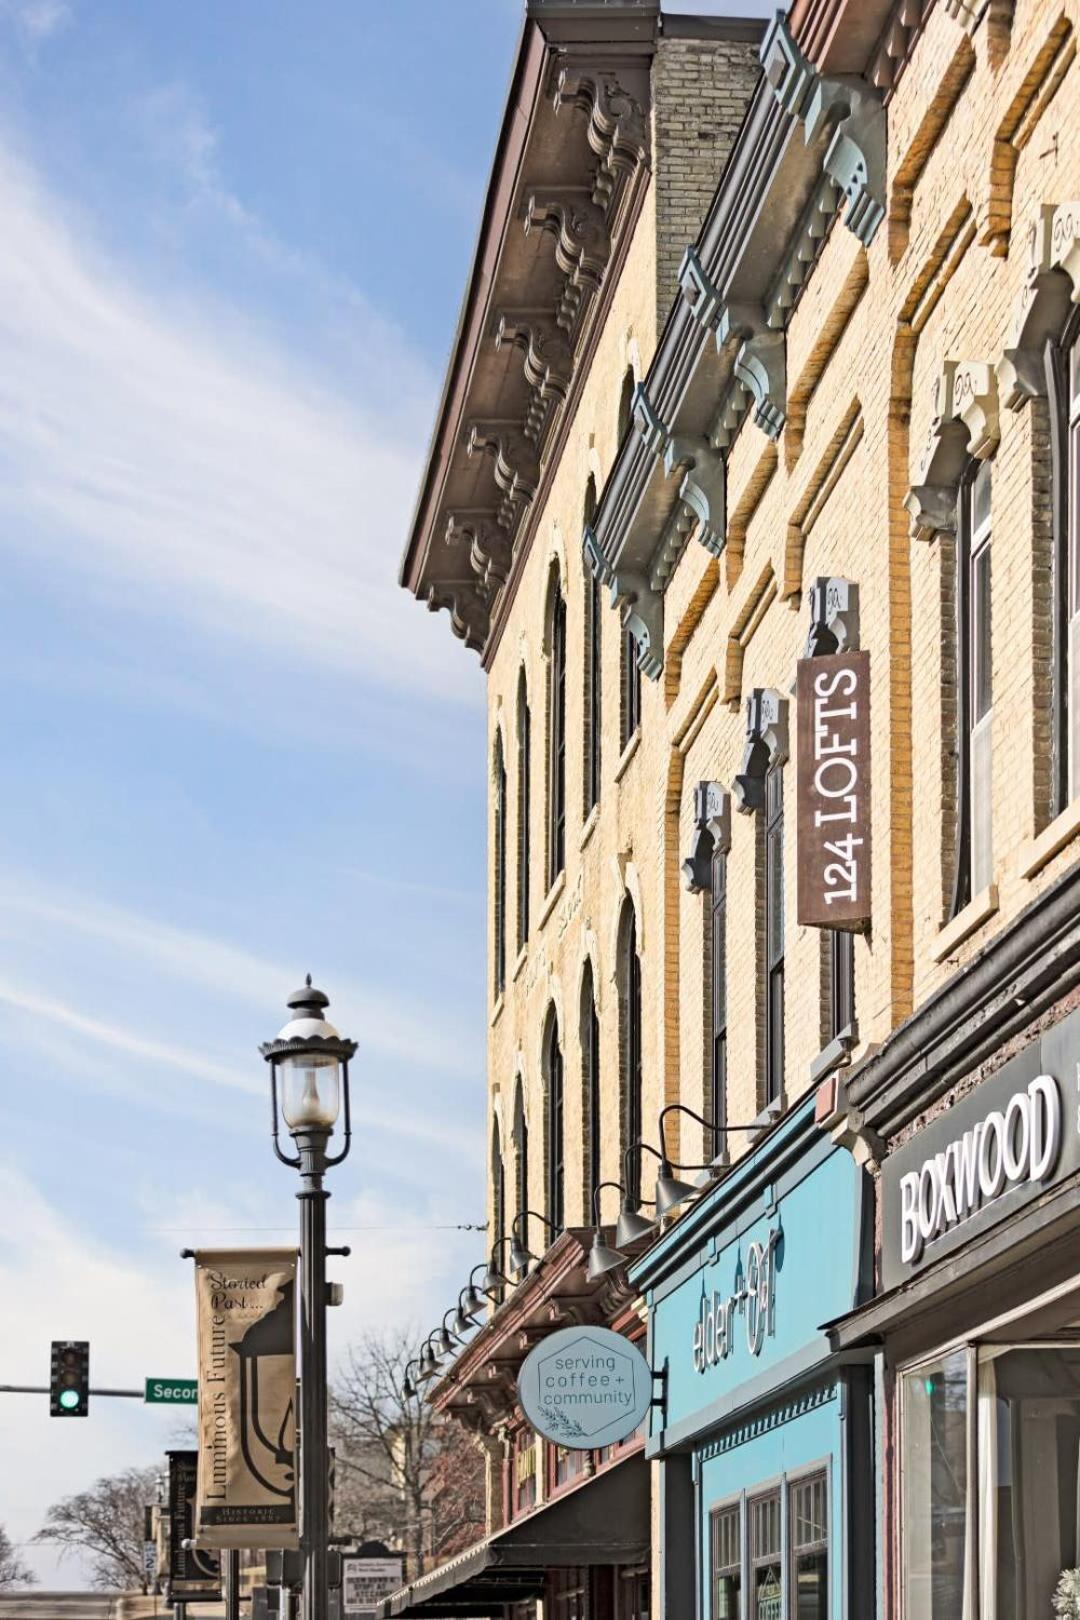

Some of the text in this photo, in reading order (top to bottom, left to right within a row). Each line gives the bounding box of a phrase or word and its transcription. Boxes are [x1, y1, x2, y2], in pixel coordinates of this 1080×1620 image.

[814, 669, 864, 905] 124 LOFTS
[900, 1074, 1060, 1264] BOXWOOD
[209, 1271, 267, 1291] Storied
[693, 1290, 736, 1374] elder
[545, 1373, 610, 1388] coffee
[555, 1355, 615, 1371] serving
[206, 1315, 227, 1500] Luminous Future
[544, 1390, 632, 1406] community
